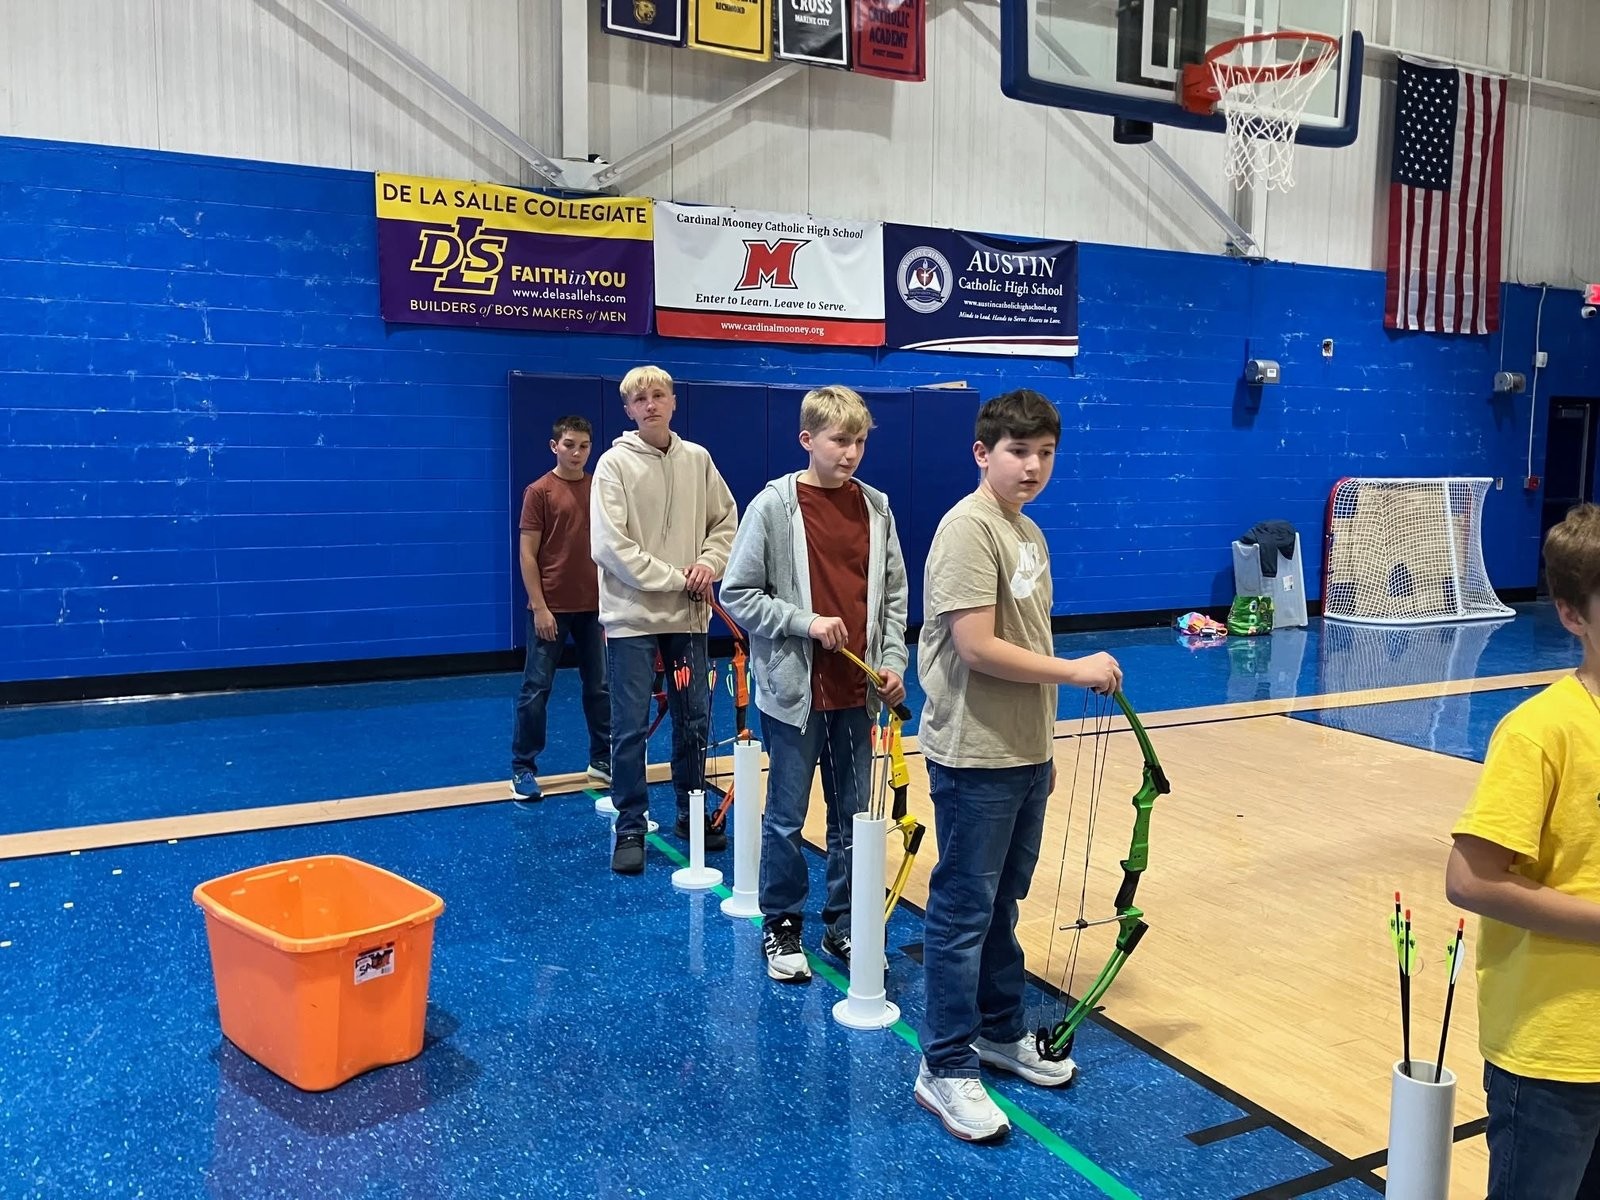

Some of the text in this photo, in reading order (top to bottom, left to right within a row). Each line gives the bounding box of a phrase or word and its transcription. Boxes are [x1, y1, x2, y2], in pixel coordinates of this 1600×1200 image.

[794, 14, 830, 26] MARINE CITY
[869, 27, 909, 48] ACADEMY
[383, 183, 647, 223] DE LA SALLE COLLEGIATE
[676, 213, 864, 239] Cardinal Mooney Catholic High School
[733, 238, 812, 291] M
[966, 250, 1057, 278] AUSTIN
[512, 287, 626, 304] www.delasallehs.com
[958, 276, 1063, 297] Catholic High School
[410, 299, 626, 324] BUILDERS of BOYS MAKERS of MEN
[695, 293, 847, 312] Enter to Learn. Leave to Serve.
[963, 299, 1058, 314] www.austincatholichighschool.org
[720, 322, 825, 336] www.cardinalmooney.org
